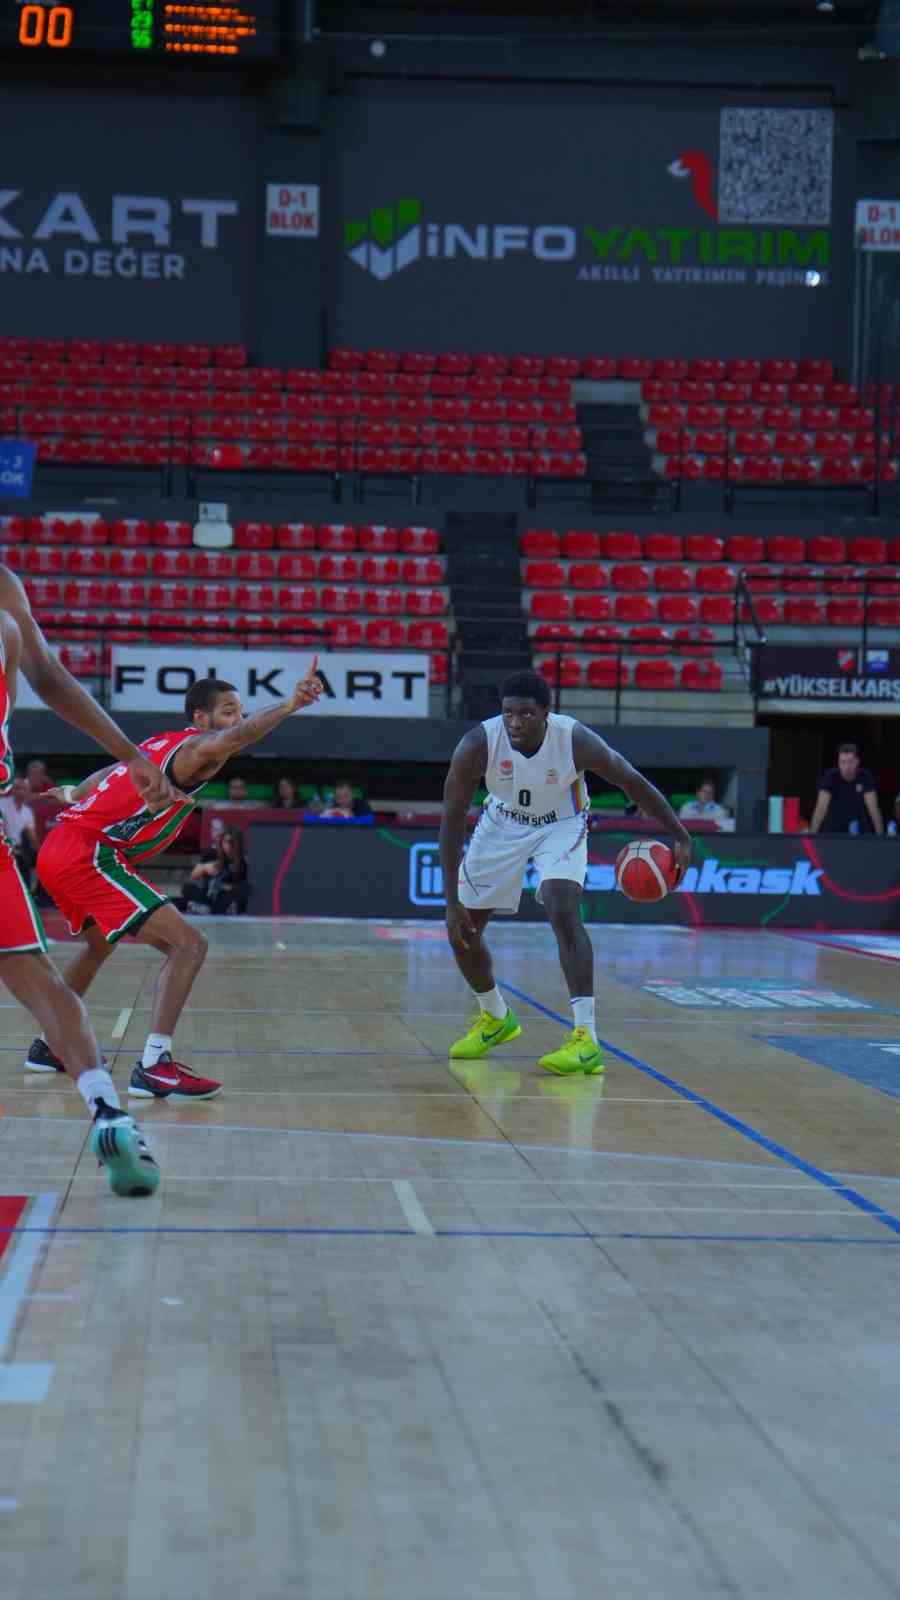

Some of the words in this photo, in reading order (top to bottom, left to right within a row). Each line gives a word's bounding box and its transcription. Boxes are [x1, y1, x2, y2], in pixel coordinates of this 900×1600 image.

[19, 4, 72, 47] 00
[279, 187, 307, 208] D-1
[271, 212, 315, 230] BLOK
[868, 205, 896, 224] D-1
[584, 228, 832, 265] YATIRIM
[63, 247, 186, 280] DEĞER
[519, 789, 531, 807] 0
